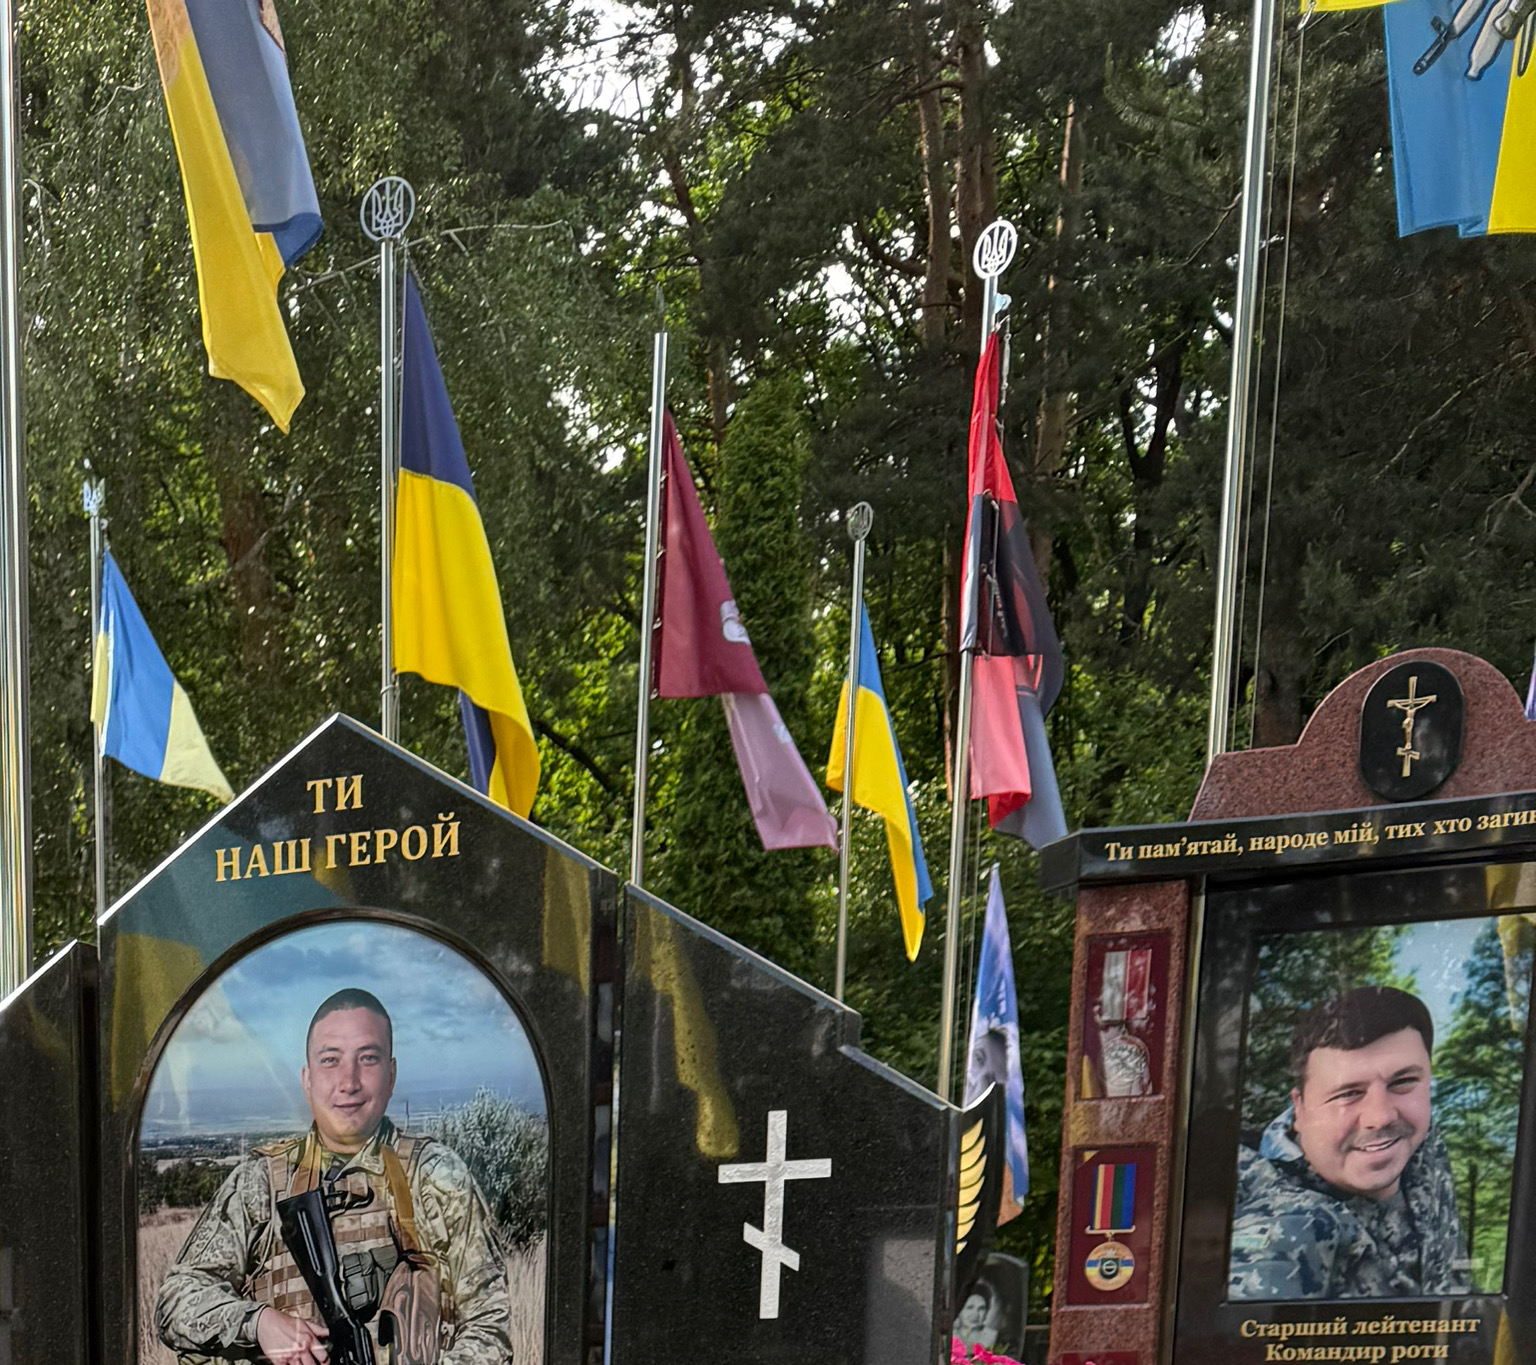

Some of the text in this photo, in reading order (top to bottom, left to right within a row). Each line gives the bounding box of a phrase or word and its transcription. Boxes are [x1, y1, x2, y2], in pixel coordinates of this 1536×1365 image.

[306, 774, 364, 814] ТИ
[215, 812, 461, 883] НАШ ГЕРОЙ
[1105, 841, 1134, 862] Ти
[1249, 831, 1329, 860] народе
[1333, 822, 1380, 847] мій,
[1384, 822, 1426, 841] тих
[1431, 816, 1472, 836] хто
[1240, 1315, 1481, 1341] Старший лейтенант
[1265, 1343, 1449, 1364] Командир роти
